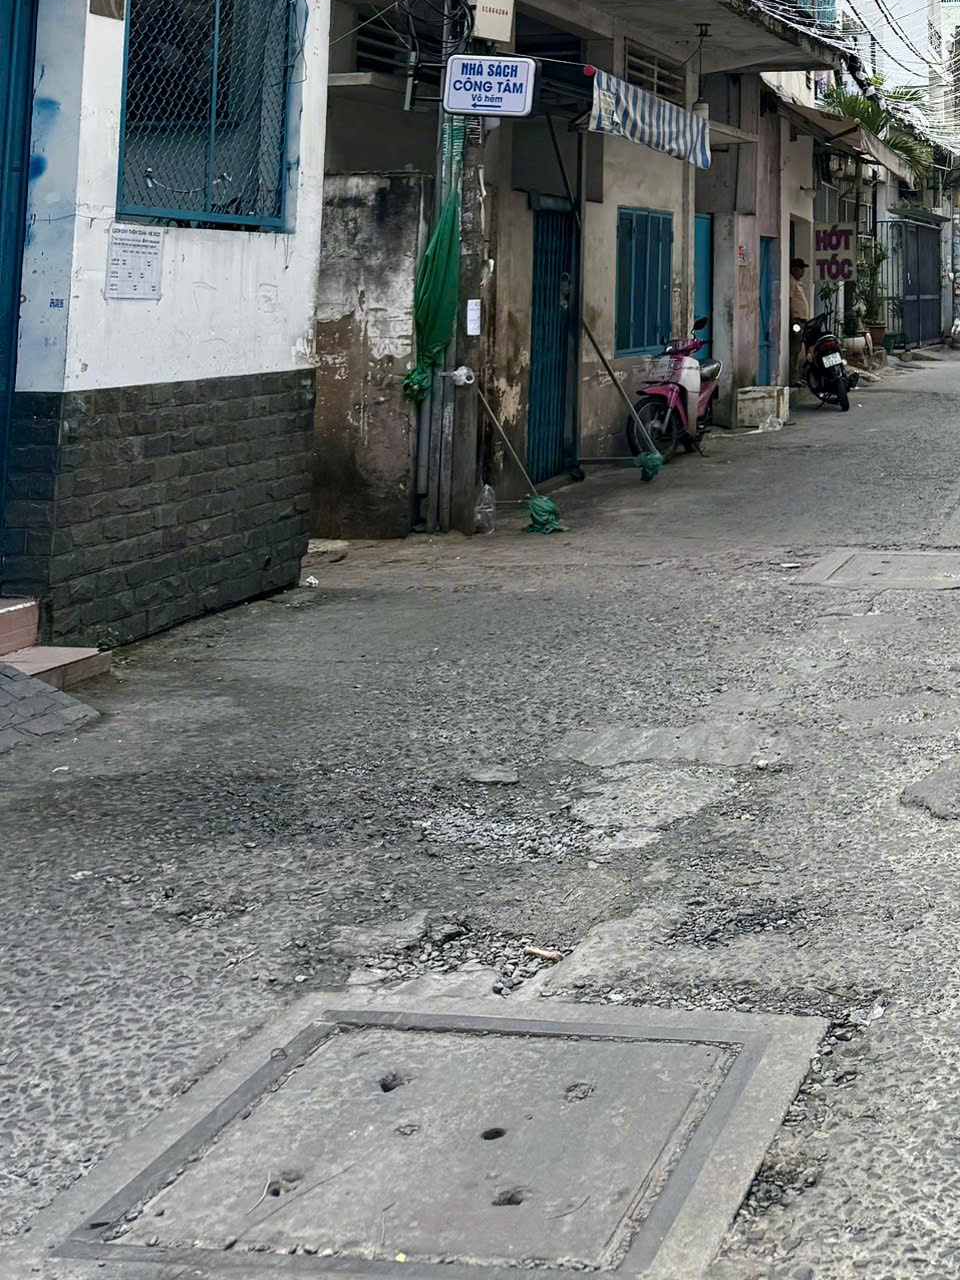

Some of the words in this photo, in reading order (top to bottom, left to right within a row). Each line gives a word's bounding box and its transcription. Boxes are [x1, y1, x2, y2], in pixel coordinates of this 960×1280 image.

[461, 61, 483, 76] NHÀ
[487, 61, 518, 78] SÁCH
[453, 77, 493, 92] CÔNG
[497, 79, 524, 94] TÂM
[816, 253, 853, 280] TÓC
